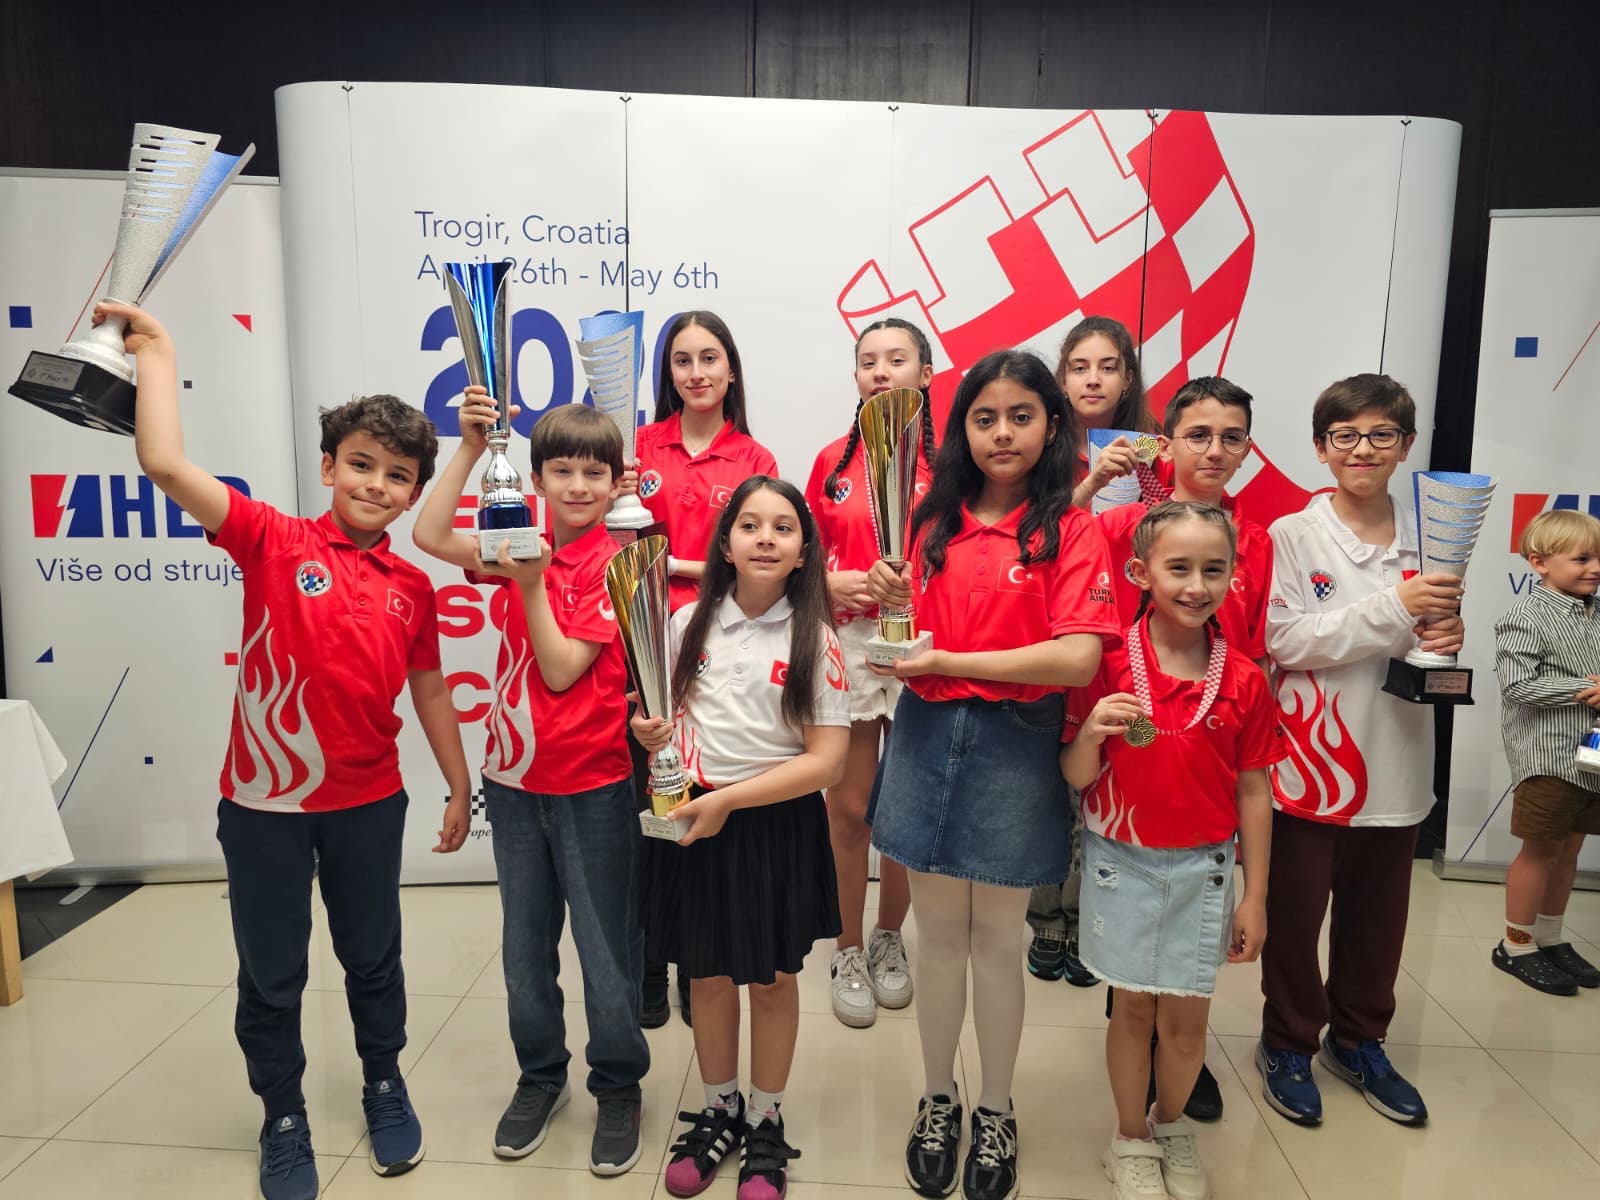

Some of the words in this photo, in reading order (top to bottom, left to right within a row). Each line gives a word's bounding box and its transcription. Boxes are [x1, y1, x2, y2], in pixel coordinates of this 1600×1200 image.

[414, 210, 510, 247] Trogir,
[522, 214, 630, 245] Croatia
[600, 260, 662, 296] May
[673, 262, 719, 289] 6th
[36, 557, 103, 583] Više
[114, 558, 151, 582] od
[164, 557, 244, 587] struje
